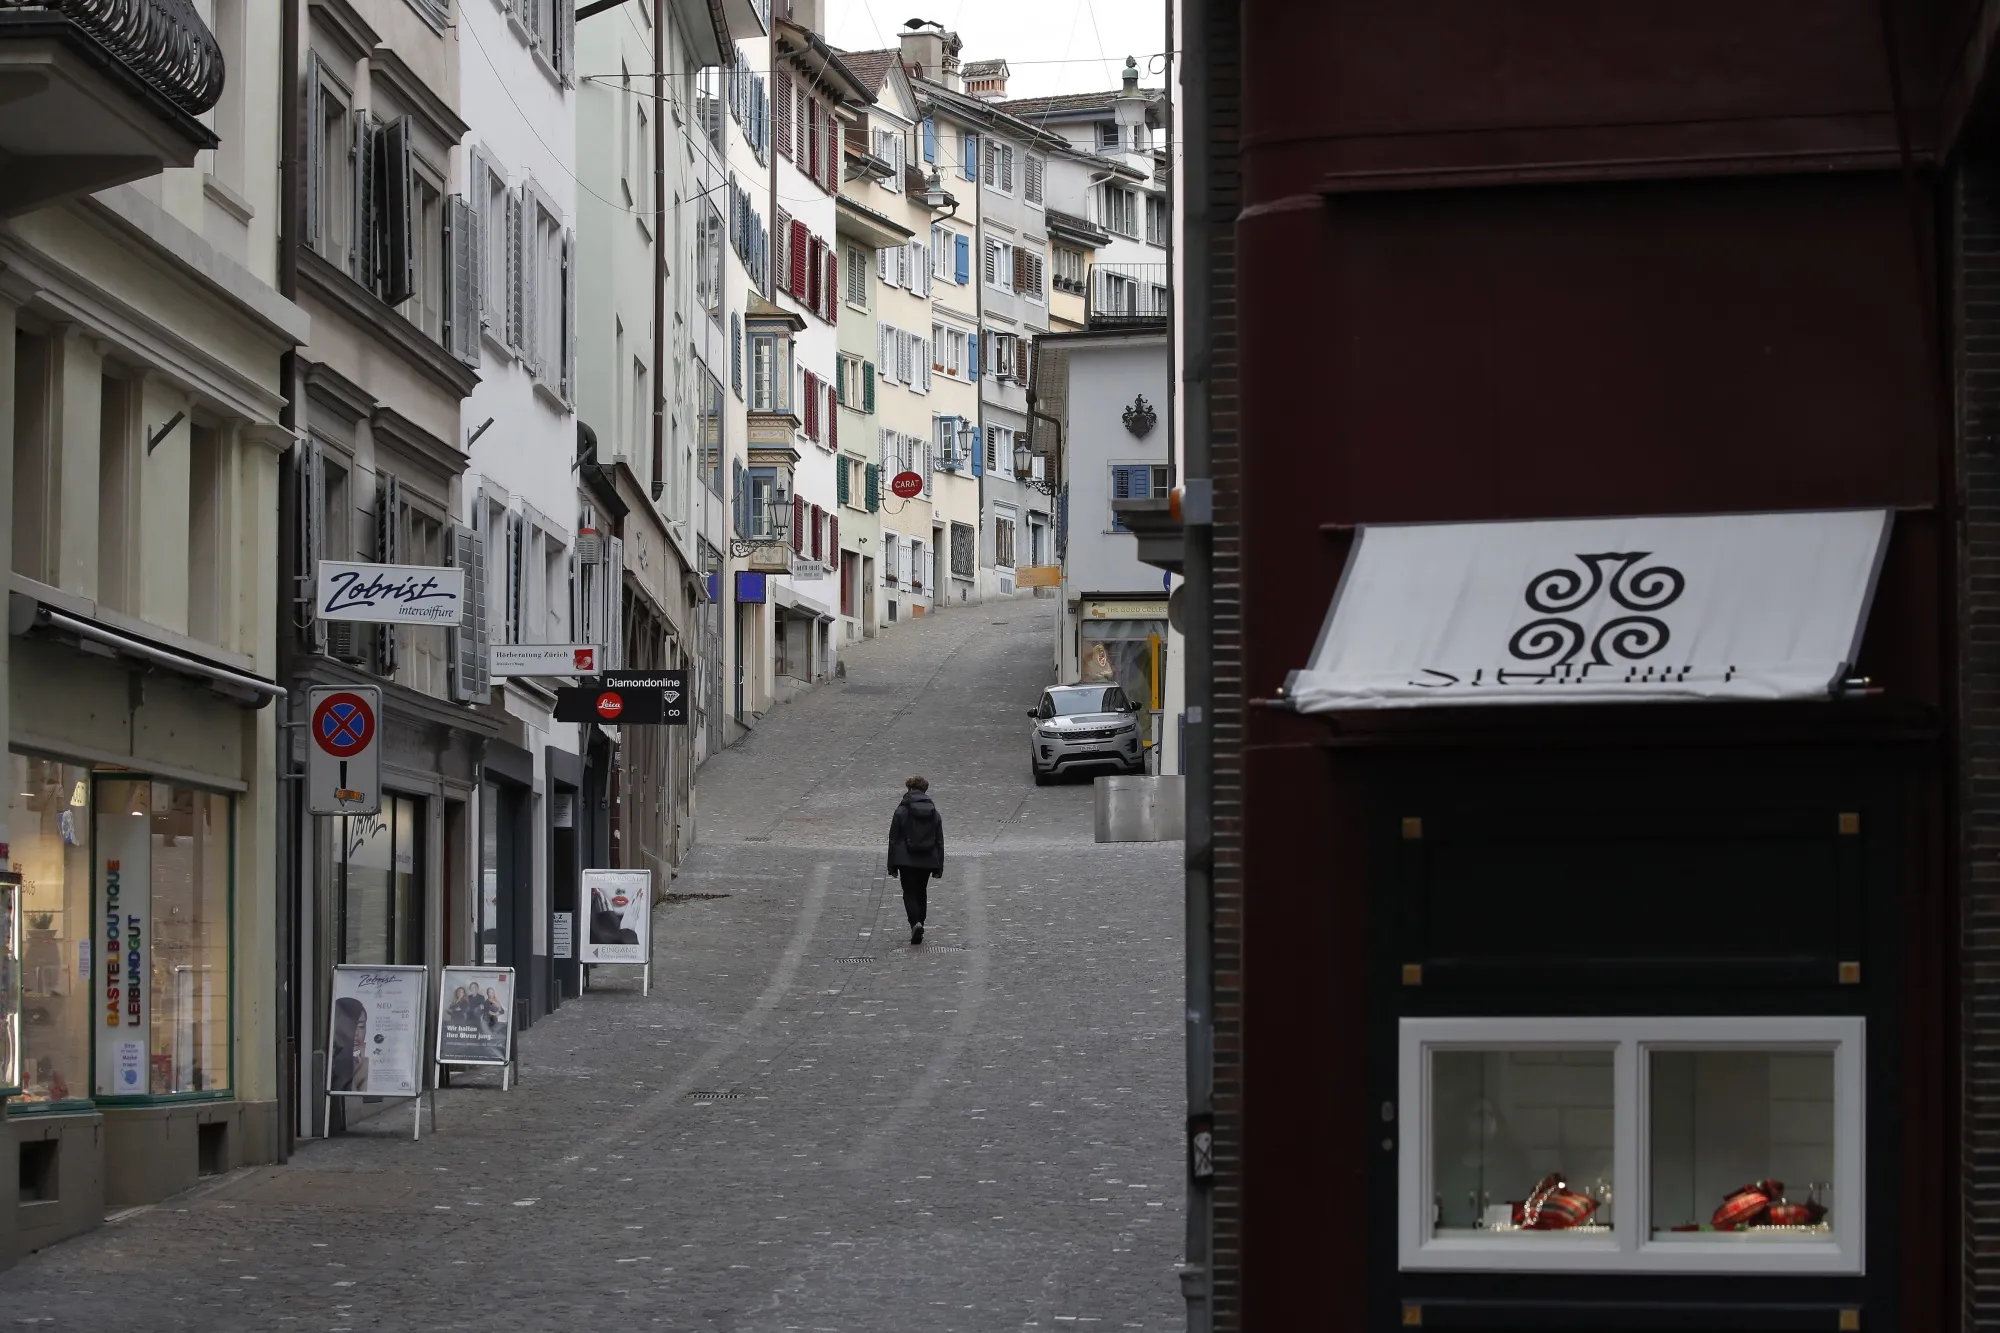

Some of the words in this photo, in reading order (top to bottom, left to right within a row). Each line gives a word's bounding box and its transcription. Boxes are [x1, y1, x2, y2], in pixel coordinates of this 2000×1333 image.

[895, 479, 920, 489] CARAT
[324, 571, 457, 612] Zobrist
[398, 604, 454, 619] intercoiffure
[496, 651, 542, 659] Hörberatung
[606, 677, 680, 688] Diamondonline
[598, 698, 621, 710] Leica
[106, 859, 121, 1027] BASTELBOUTIQUE
[127, 914, 141, 1028] LEIBUNDGUT
[358, 974, 403, 987] Zobrist
